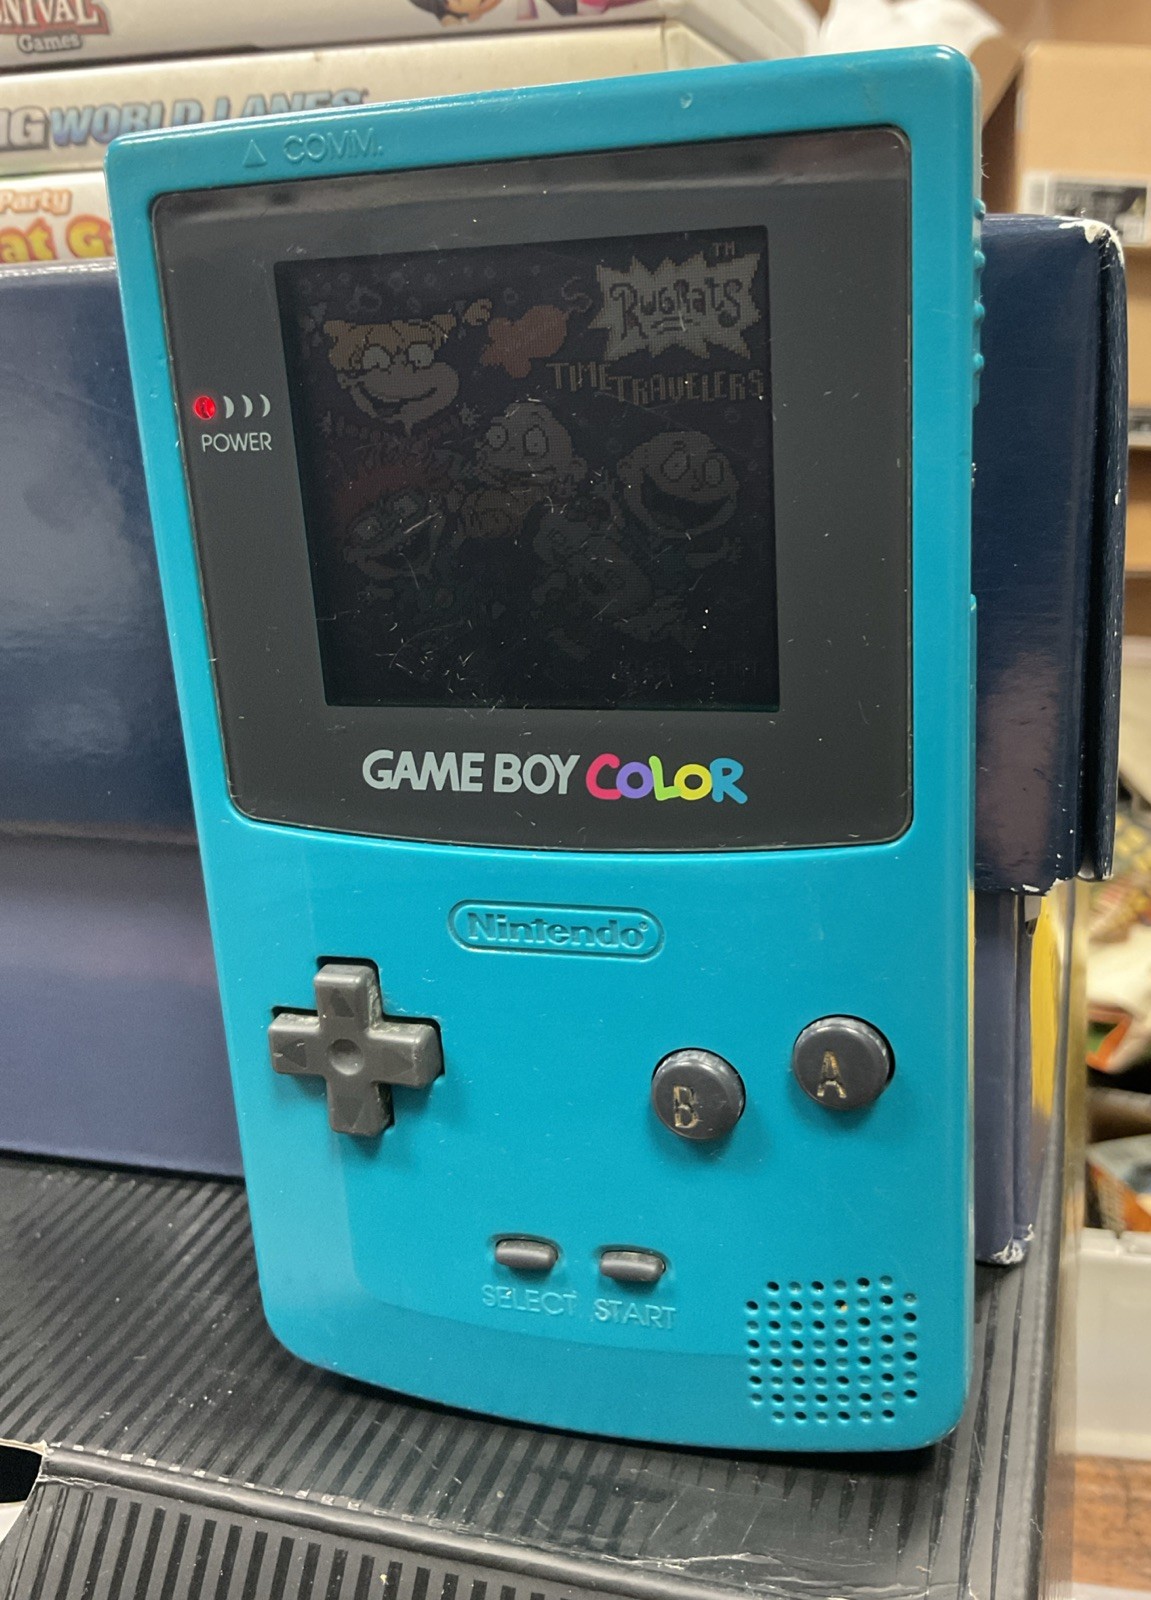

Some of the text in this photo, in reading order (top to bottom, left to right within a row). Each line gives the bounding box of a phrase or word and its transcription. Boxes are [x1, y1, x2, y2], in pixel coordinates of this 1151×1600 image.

[19, 33, 81, 52] Games
[66, 214, 115, 258] G
[545, 361, 765, 405] TIME TRAVELERS
[201, 432, 272, 452] POWER
[362, 749, 748, 804] GAME BOY COLOR
[816, 1050, 848, 1099] A
[672, 1085, 699, 1129] B
[481, 1284, 577, 1316] SELECT
[593, 1298, 677, 1330] START
